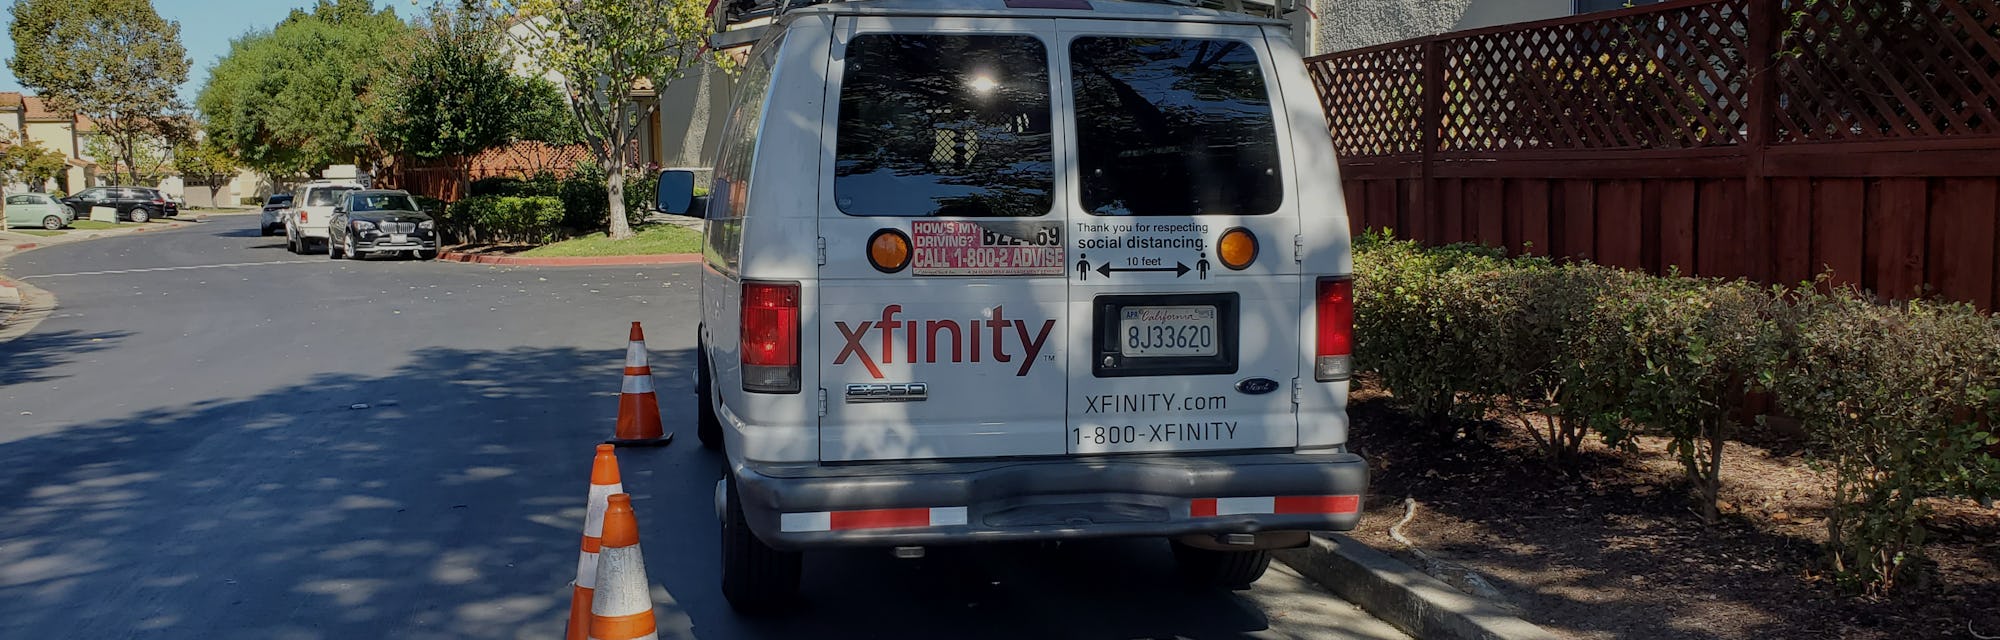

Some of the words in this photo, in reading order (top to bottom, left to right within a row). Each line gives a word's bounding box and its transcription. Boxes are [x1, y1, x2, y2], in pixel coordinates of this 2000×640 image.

[914, 222, 954, 234] HOW'S
[959, 222, 977, 233] MY
[1077, 222, 1109, 233] Thank
[1113, 224, 1132, 235] you
[1135, 222, 1151, 233] for
[1153, 222, 1209, 235] respecting
[916, 235, 975, 247] DRIVING?
[1078, 236, 1121, 249] social
[1126, 235, 1208, 252] distancing.
[914, 248, 950, 268] CALL
[953, 248, 1009, 267] 1-800-2
[1012, 247, 1064, 267] ADVISE
[1127, 257, 1138, 266] 10
[1141, 256, 1162, 266] feet
[832, 304, 1057, 379] xfinity
[1128, 325, 1211, 348] 8J33620
[1085, 393, 1226, 414] XFINITY.com
[1073, 421, 1238, 445] 1-800-XFINITY
